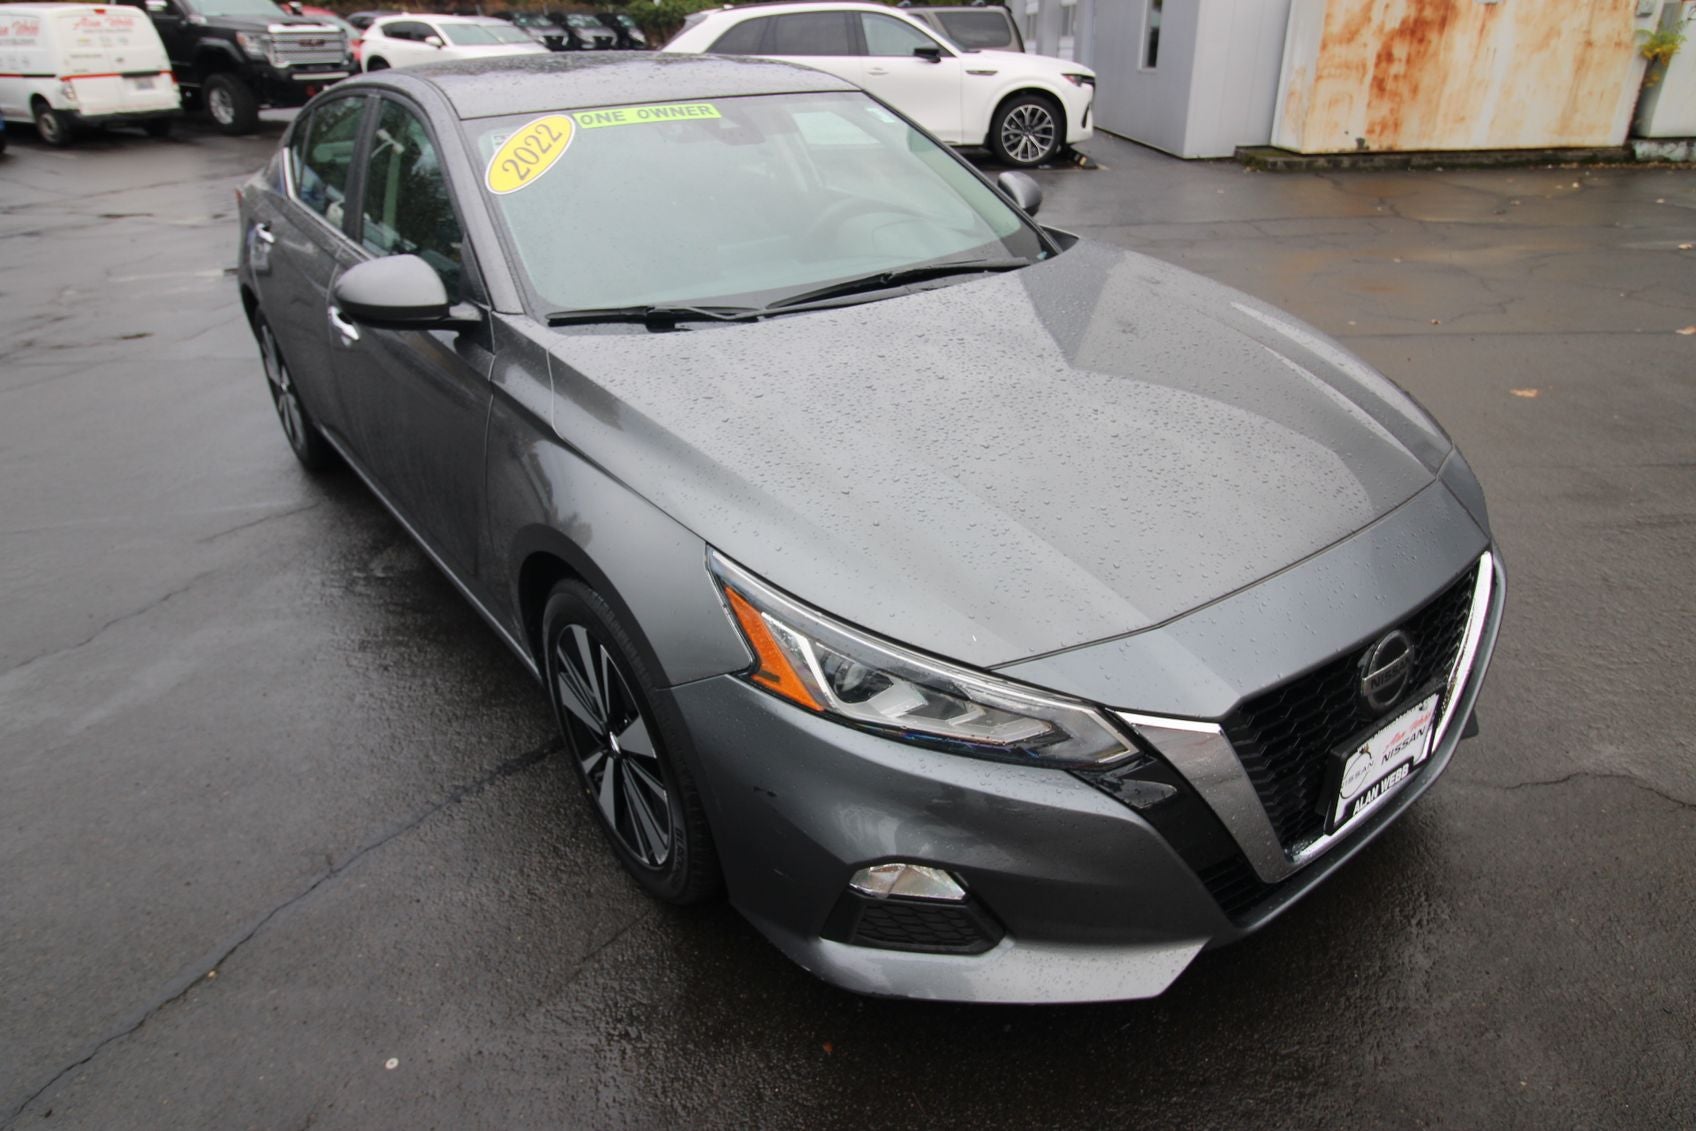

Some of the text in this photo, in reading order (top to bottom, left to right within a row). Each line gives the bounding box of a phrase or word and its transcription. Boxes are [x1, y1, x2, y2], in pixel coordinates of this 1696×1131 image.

[580, 105, 714, 126] ONE OWNER
[502, 123, 563, 181] 2022
[1370, 656, 1409, 689] NISSAN
[1381, 726, 1426, 765] NISSAN
[1352, 762, 1410, 817] ALAN WEBB
